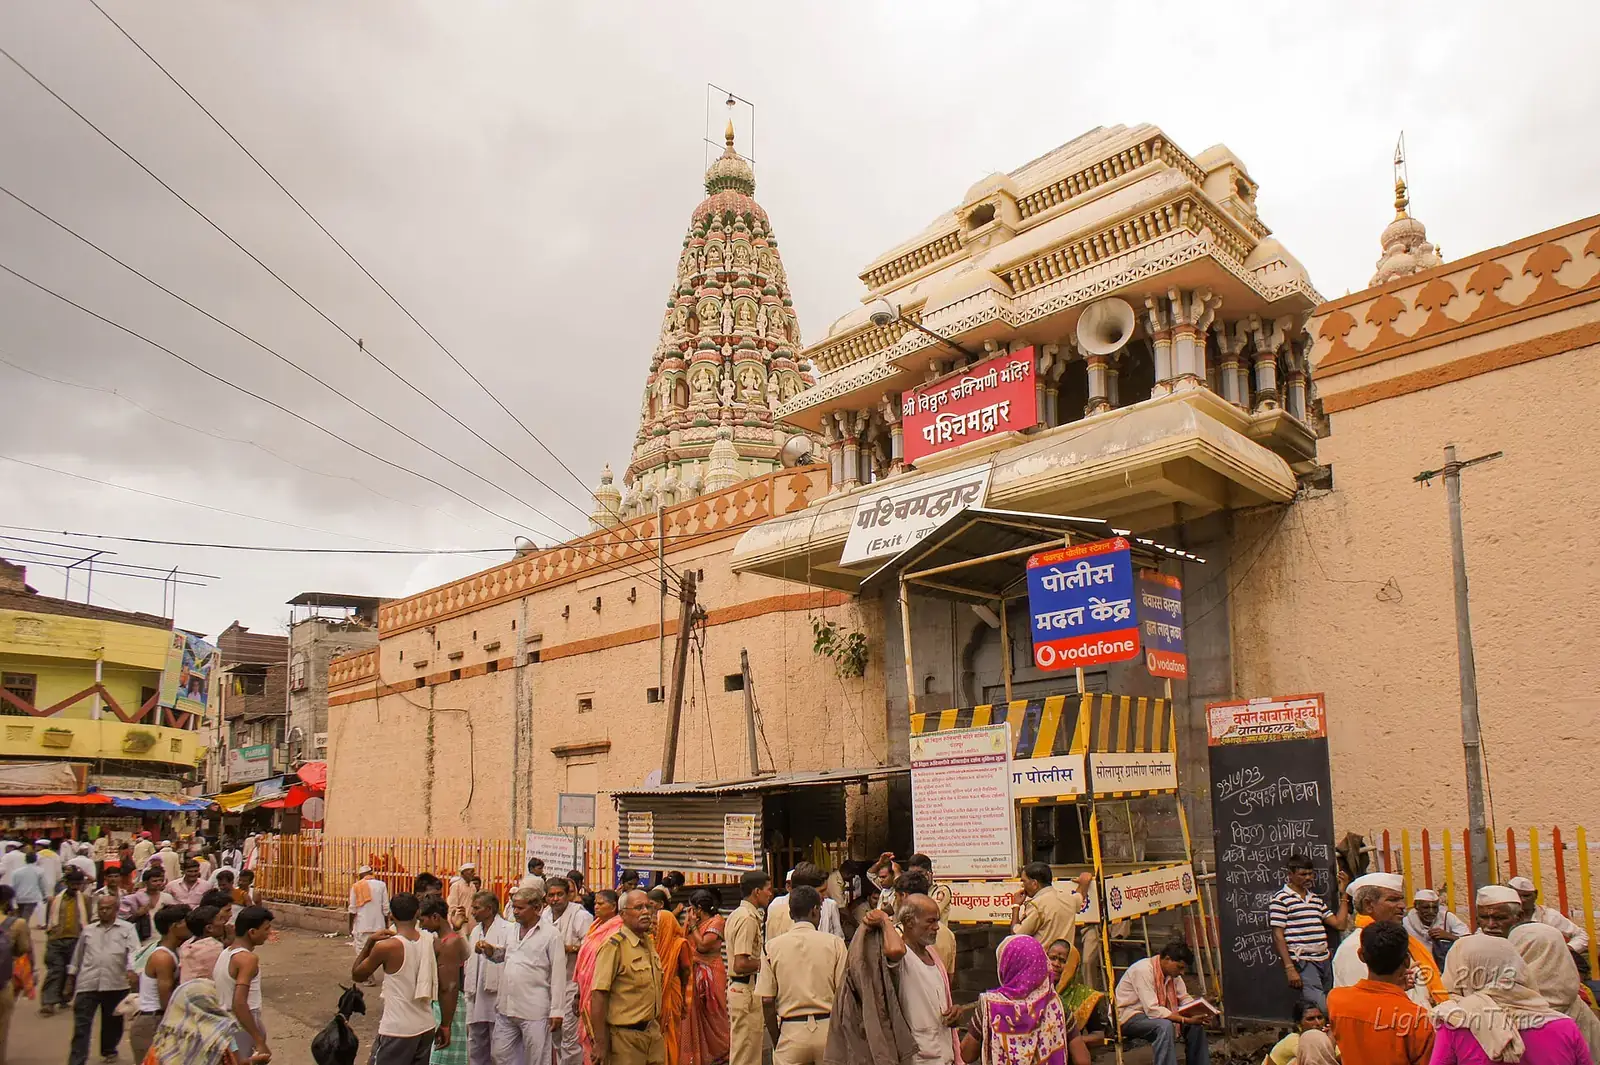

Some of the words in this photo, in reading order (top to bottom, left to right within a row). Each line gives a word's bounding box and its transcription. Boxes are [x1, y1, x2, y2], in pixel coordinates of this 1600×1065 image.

[903, 397, 915, 417] श्री
[1000, 360, 1030, 382] मंदिर
[922, 400, 1010, 445] पश्चिमद्वार
[857, 480, 983, 529] पश्चिमद्वार
[1041, 561, 1115, 592] पोलीस
[1035, 606, 1085, 631] मदत
[1088, 596, 1132, 623] केंद्र
[1058, 639, 1135, 661] vodafone
[1156, 658, 1186, 674] vodafone
[1233, 707, 1258, 725] वसंत
[1025, 766, 1074, 785] पोलीस
[1096, 760, 1124, 782] सोलापूर
[1125, 760, 1147, 778] ग्रामीण
[1149, 760, 1172, 776] पोलीस
[1278, 776, 1321, 806] निधन
[993, 892, 1015, 907] स्टी
